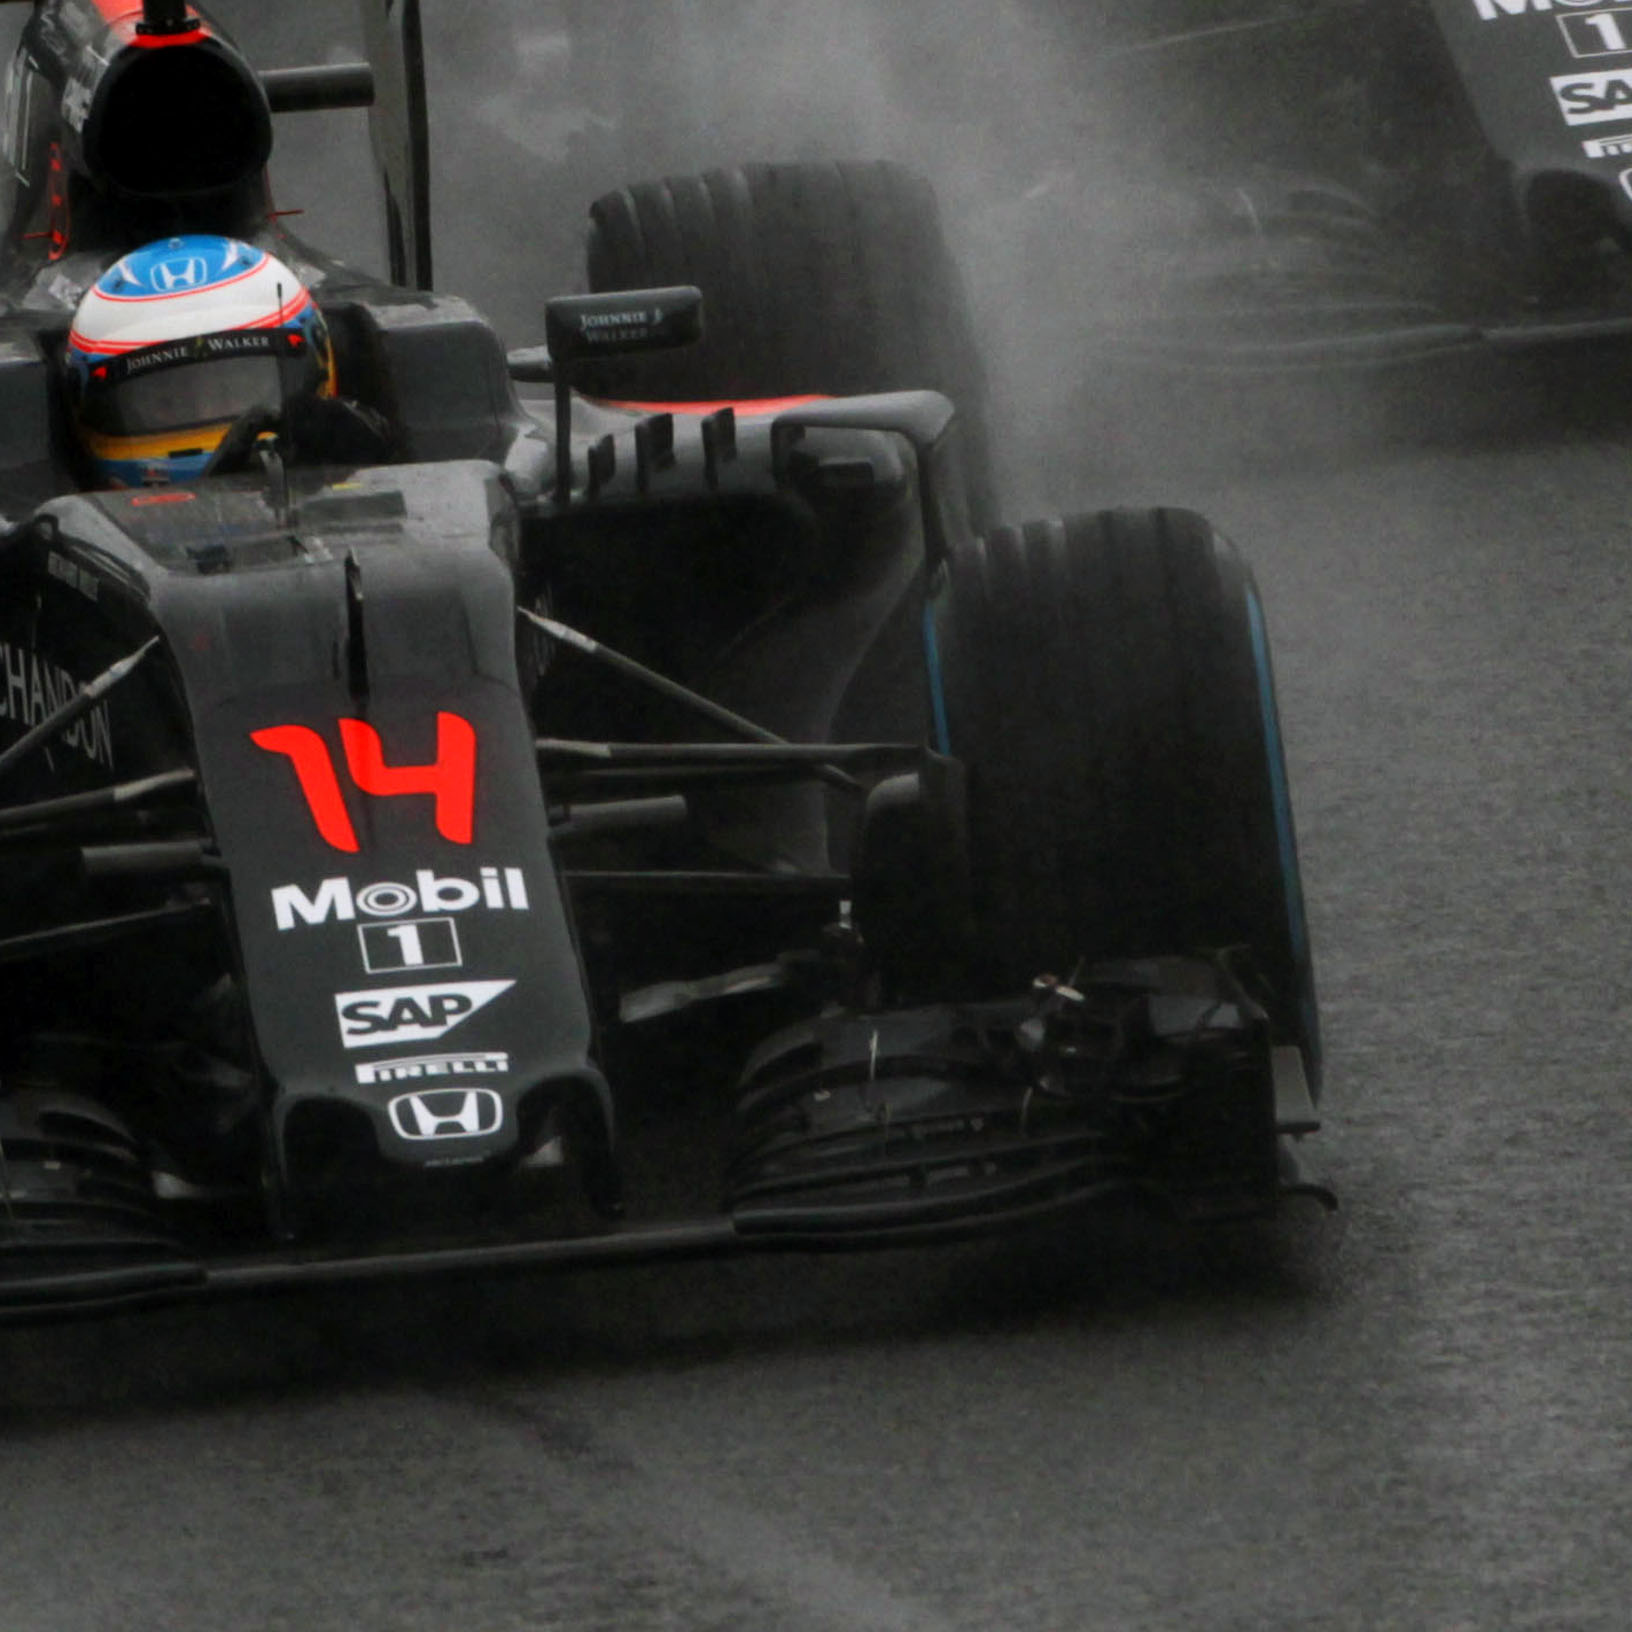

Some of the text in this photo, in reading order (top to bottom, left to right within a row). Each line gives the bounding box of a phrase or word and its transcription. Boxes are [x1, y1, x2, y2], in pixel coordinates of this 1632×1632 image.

[1584, 15, 1630, 50] 1
[250, 711, 477, 853] 14
[272, 867, 529, 930] Mobil
[386, 925, 424, 966] 1
[342, 993, 473, 1035] SAP
[355, 1053, 509, 1084] PIRELLI
